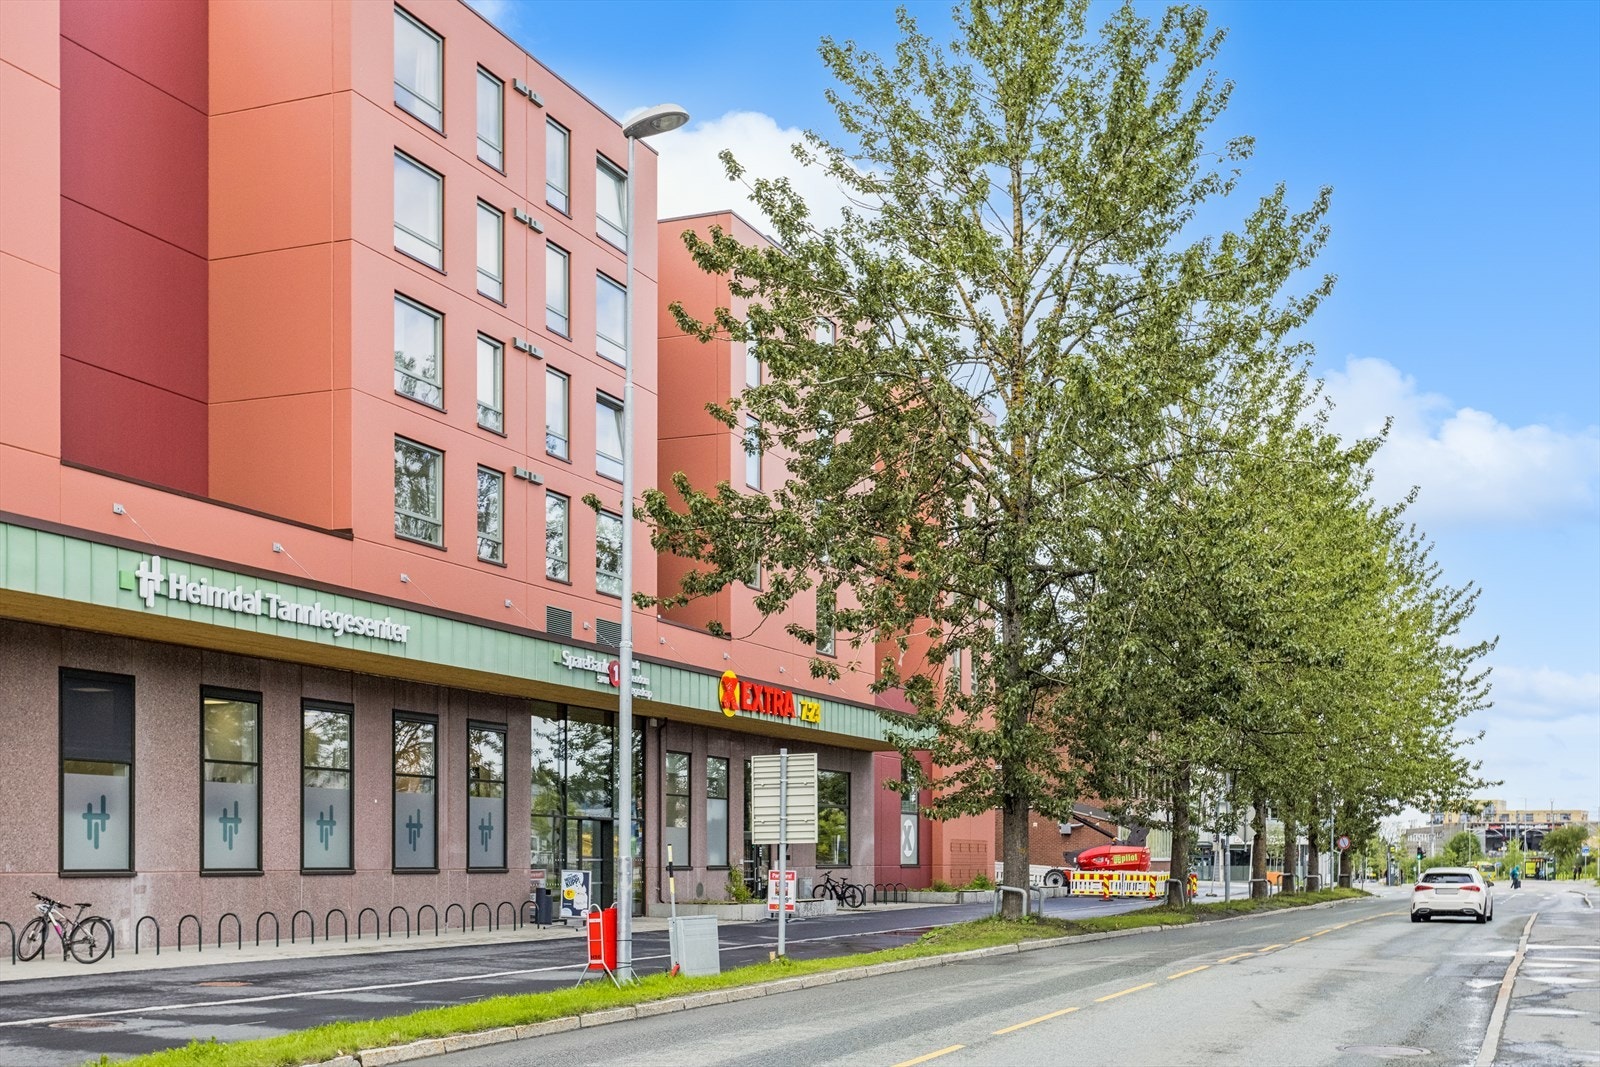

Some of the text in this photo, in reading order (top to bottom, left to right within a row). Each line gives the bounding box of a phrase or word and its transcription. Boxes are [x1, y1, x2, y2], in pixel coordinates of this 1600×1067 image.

[169, 573, 411, 643] Heimdal Tannlegesenter
[562, 650, 610, 674] SpareBank
[740, 681, 797, 718] EXTRA
